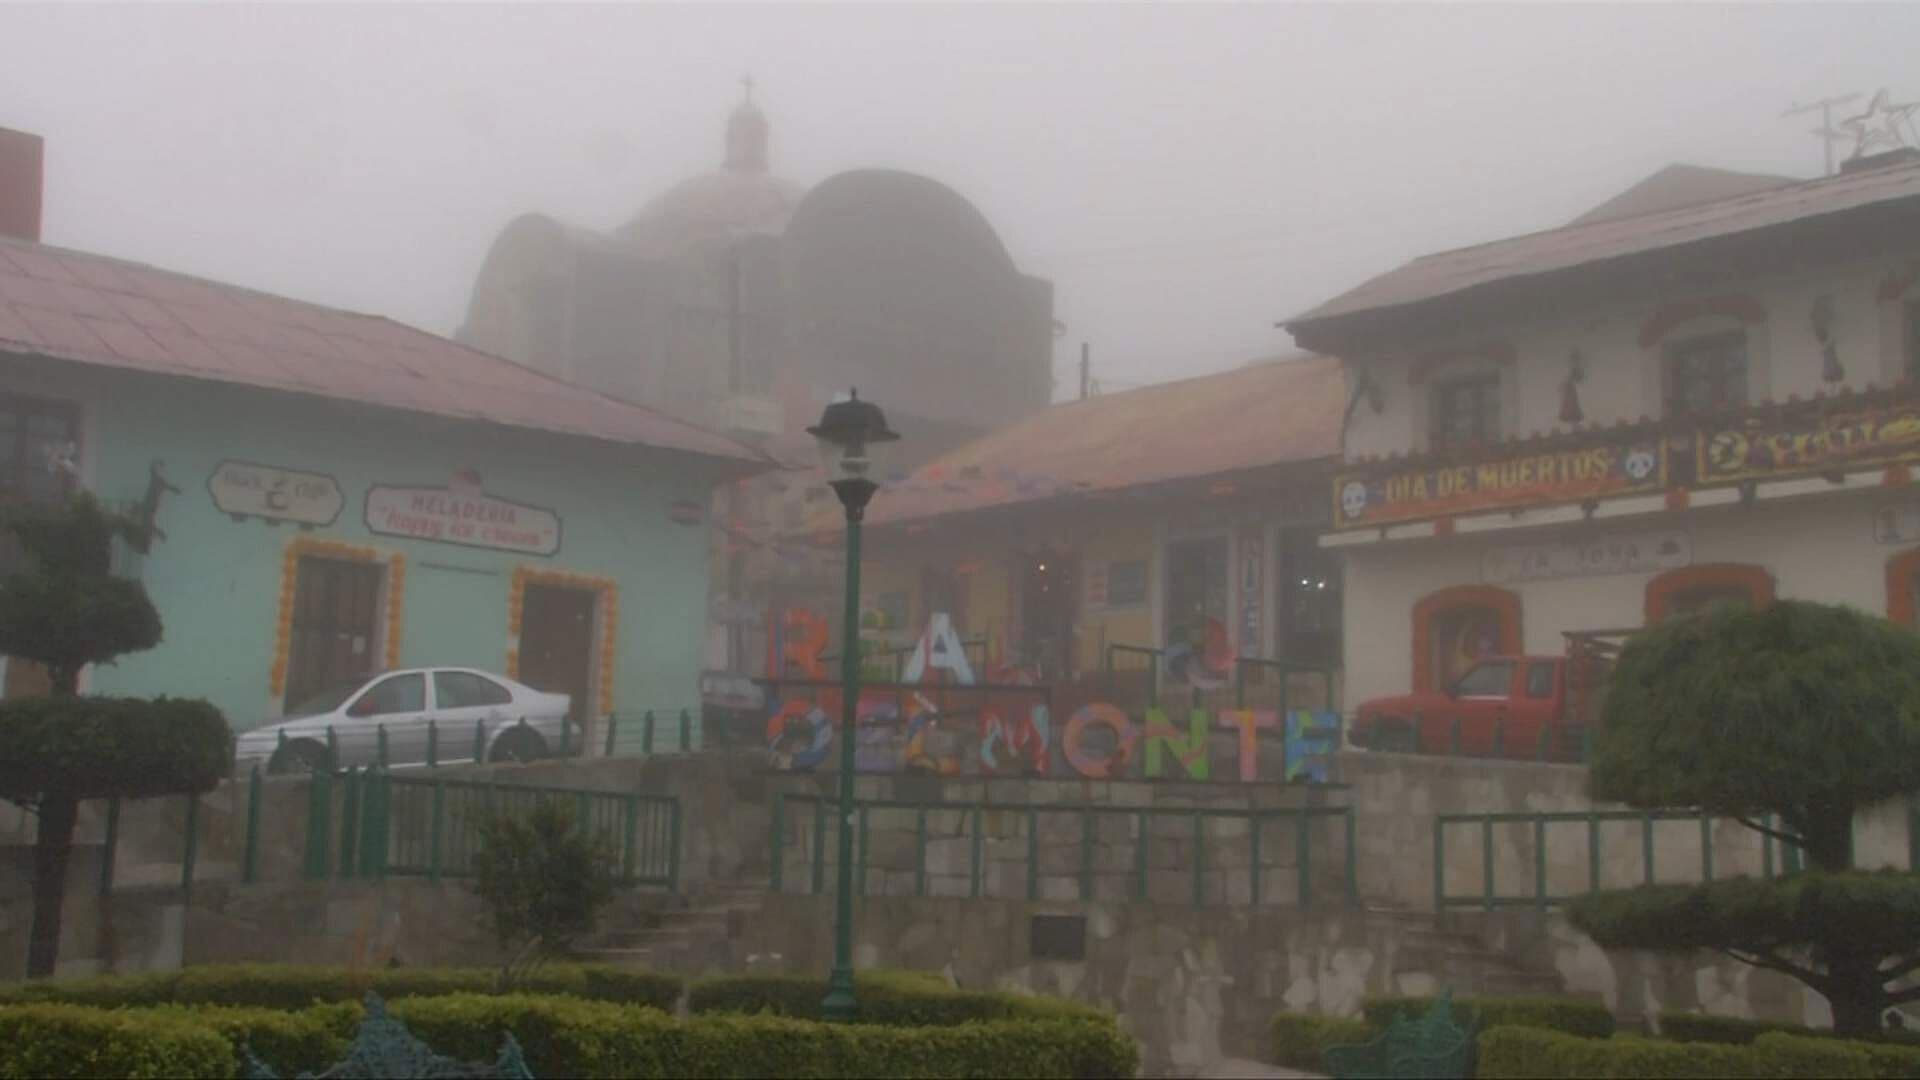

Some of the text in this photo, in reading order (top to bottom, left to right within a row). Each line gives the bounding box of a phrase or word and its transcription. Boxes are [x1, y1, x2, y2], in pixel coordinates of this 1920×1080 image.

[1438, 465, 1471, 497] DE
[1476, 447, 1610, 491] MUERTOS
[768, 608, 1040, 687] REAL
[978, 701, 1341, 783] MONTE
